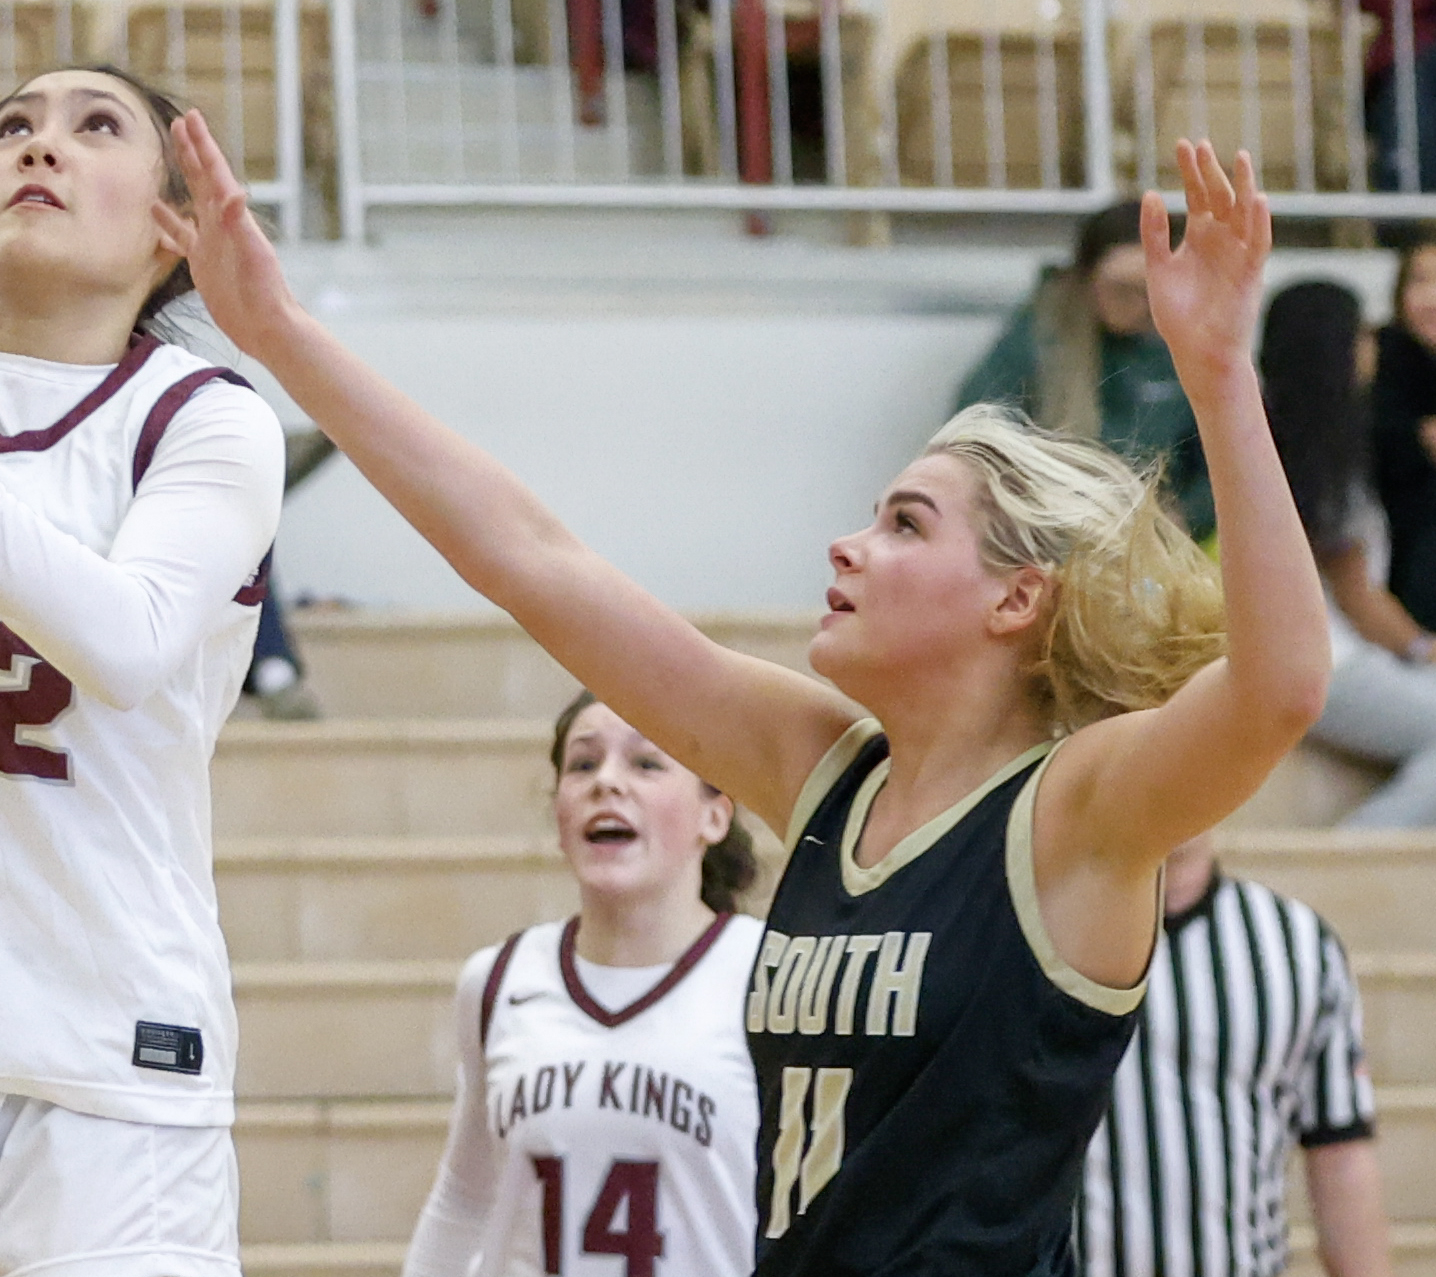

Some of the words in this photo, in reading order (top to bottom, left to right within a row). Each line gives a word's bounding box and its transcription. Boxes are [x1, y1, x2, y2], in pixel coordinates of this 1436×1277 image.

[746, 929, 934, 1037] SOUTH
[496, 1061, 586, 1139] LADY
[598, 1060, 716, 1148] KINGS
[765, 1066, 855, 1240] 11
